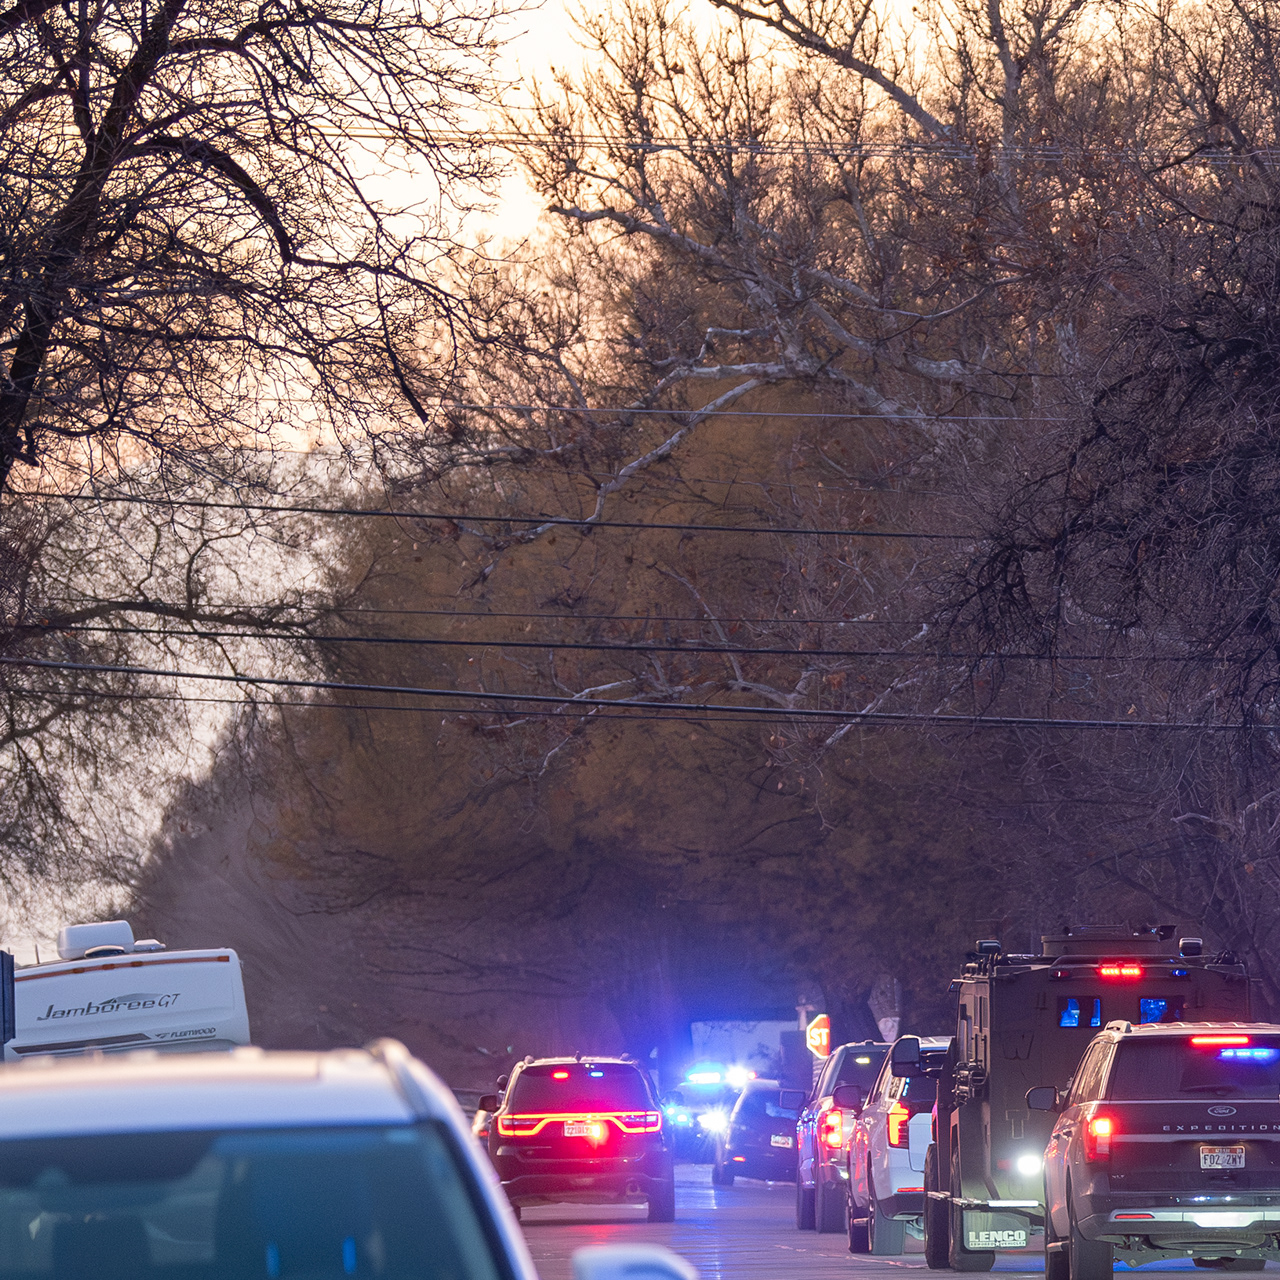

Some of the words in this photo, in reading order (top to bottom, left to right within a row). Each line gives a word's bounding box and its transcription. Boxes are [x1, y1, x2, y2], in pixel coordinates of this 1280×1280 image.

[36, 999, 155, 1021] Jamboree
[157, 993, 181, 1008] GT
[809, 1027, 830, 1046] ST
[968, 1230, 1026, 1242] LENCO
